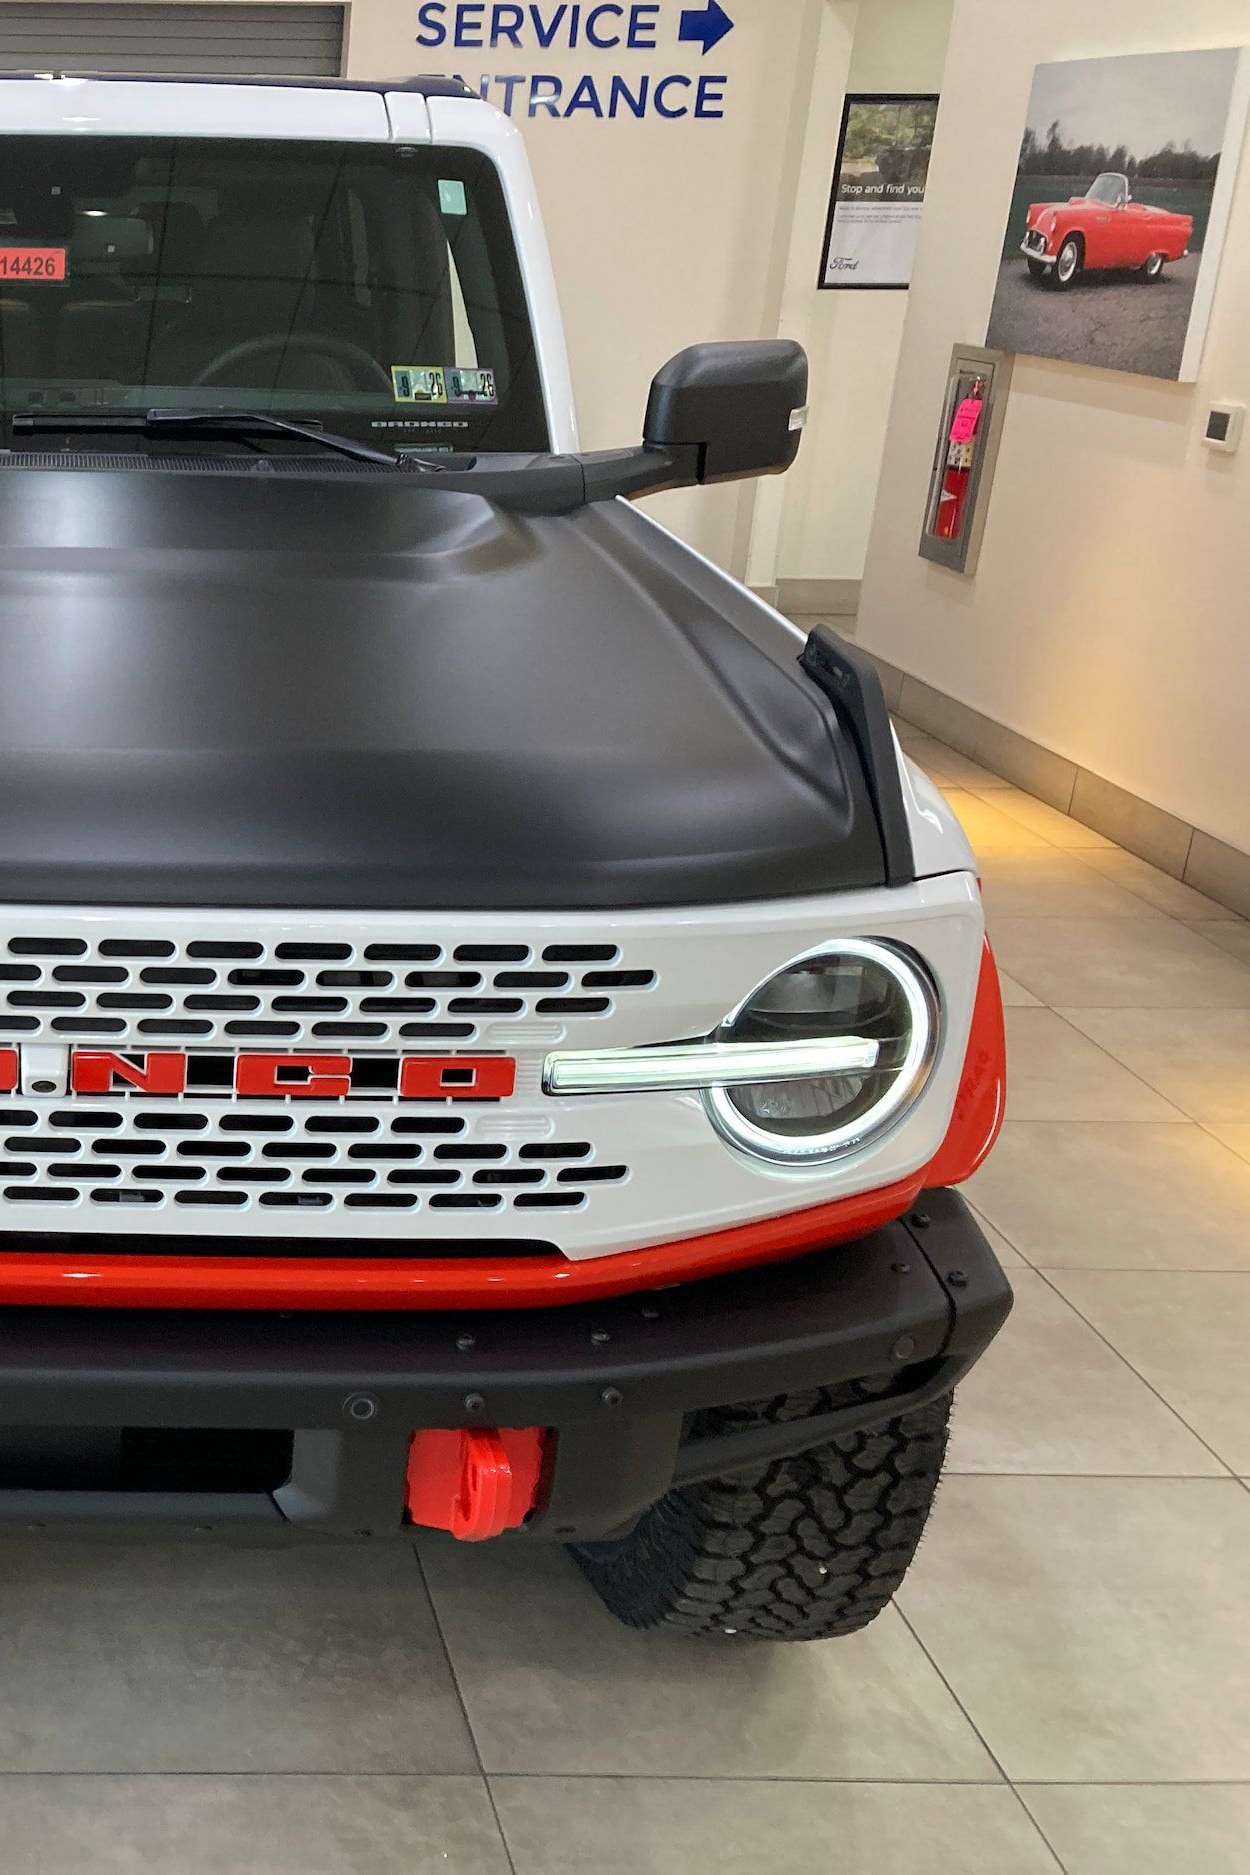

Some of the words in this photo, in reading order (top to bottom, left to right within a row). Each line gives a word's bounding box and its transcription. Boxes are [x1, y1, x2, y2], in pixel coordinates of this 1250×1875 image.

[415, 2, 660, 48] SERVICE
[841, 184, 863, 195] Stop
[865, 184, 883, 194] and
[886, 184, 905, 194] find
[829, 256, 859, 271] Ford
[401, 376, 409, 397] 9
[429, 372, 443, 396] 26
[480, 373, 495, 397] 26
